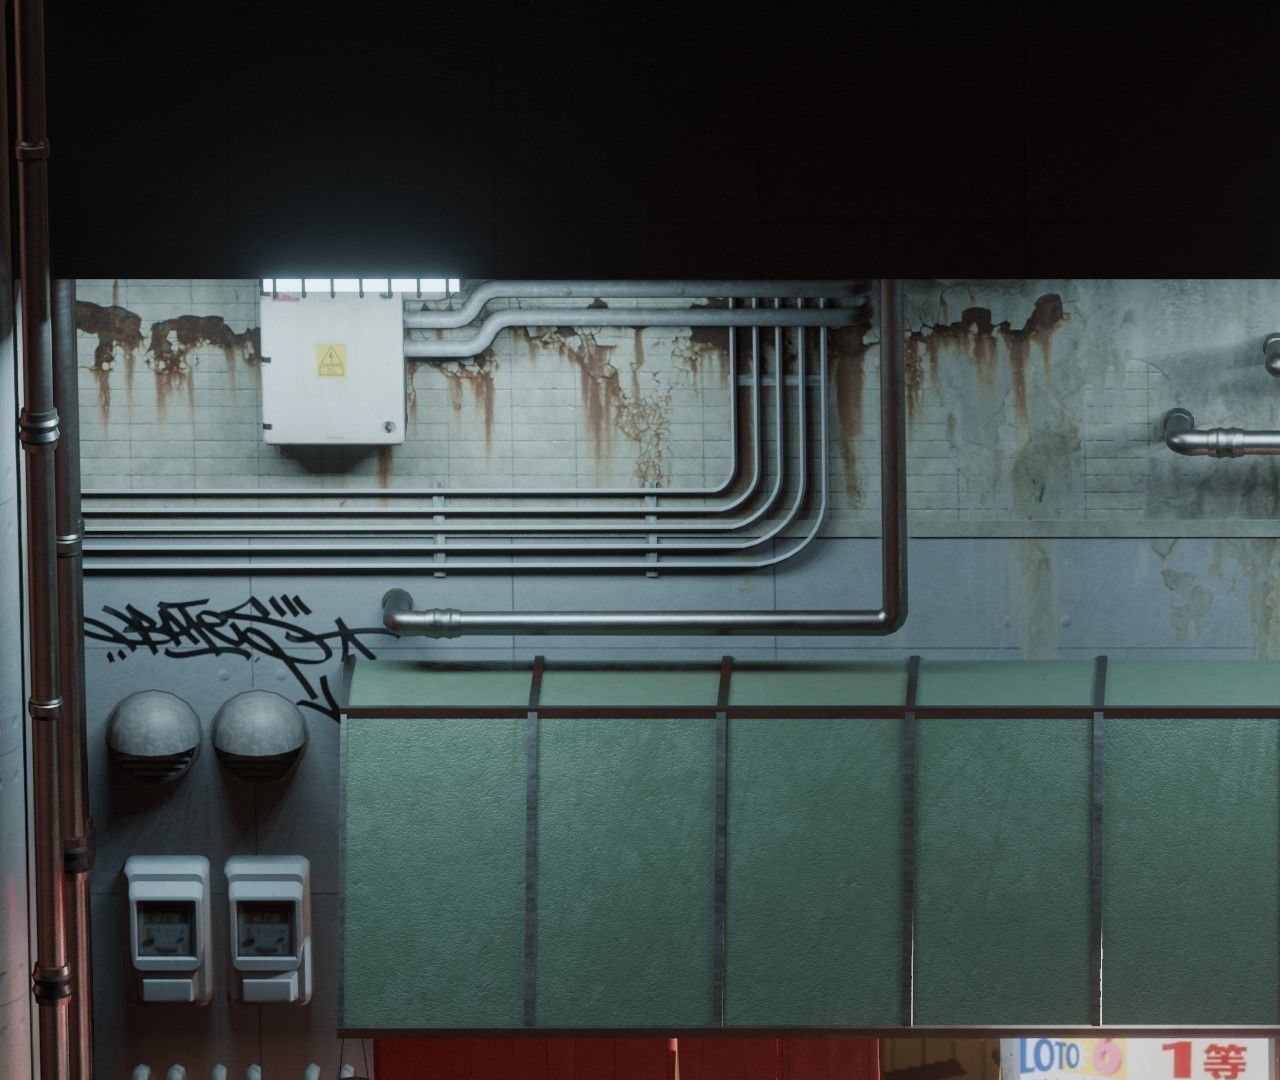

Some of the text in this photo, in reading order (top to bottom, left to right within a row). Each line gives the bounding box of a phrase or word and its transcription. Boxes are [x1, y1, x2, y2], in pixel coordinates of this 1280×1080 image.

[1020, 1038, 1123, 1076] LOTO 6
[1162, 1041, 1247, 1080] 1等
